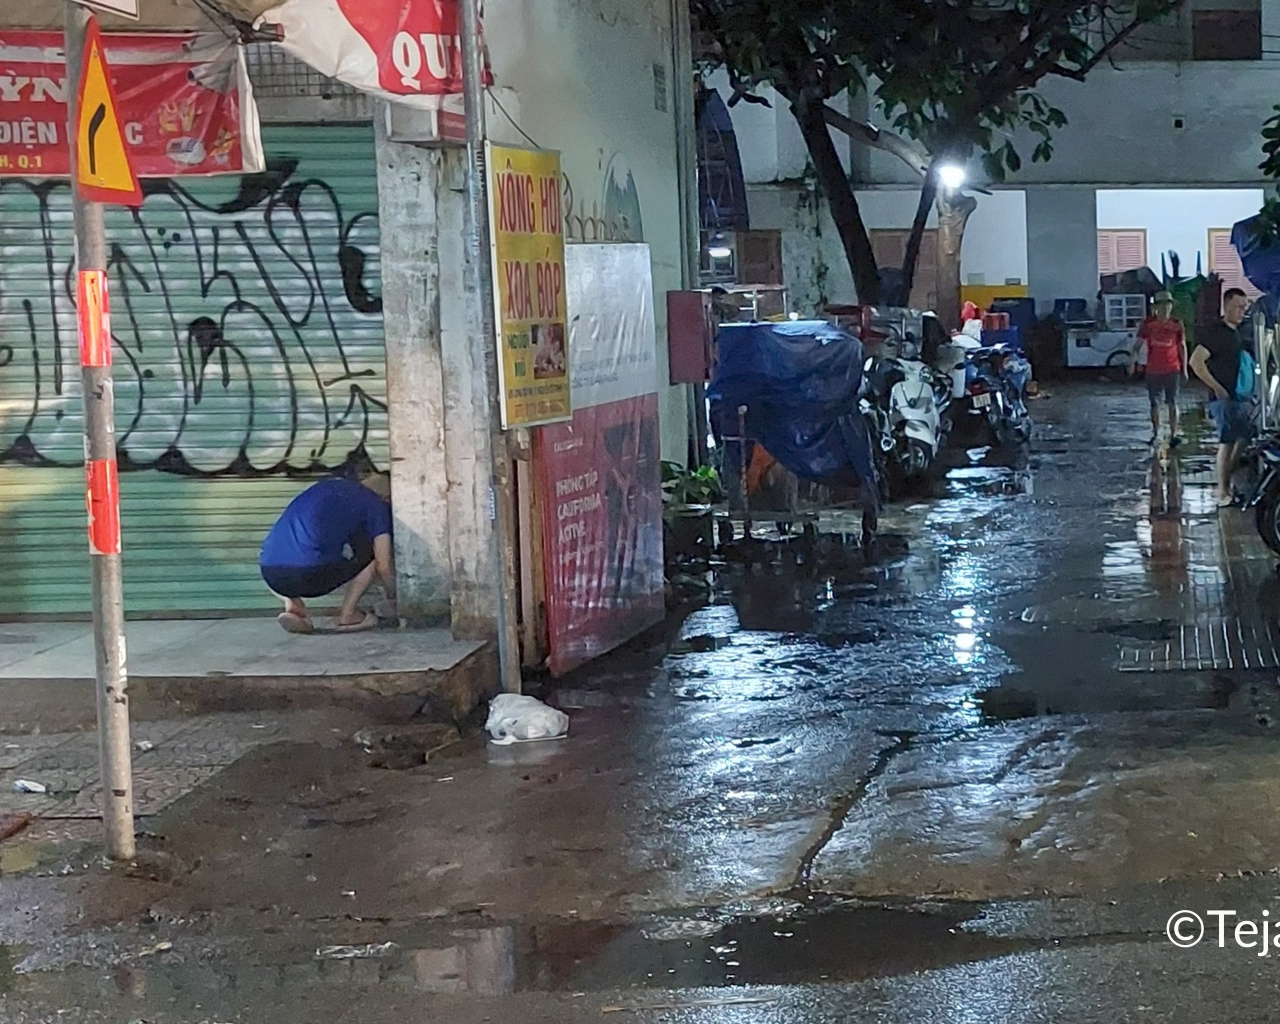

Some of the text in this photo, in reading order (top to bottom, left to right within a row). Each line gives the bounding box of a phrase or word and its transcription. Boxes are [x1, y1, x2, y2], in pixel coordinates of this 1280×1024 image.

[18, 155, 42, 168] Q.1
[497, 158, 535, 233] XÔNG
[505, 246, 561, 320] XOA BÓP
